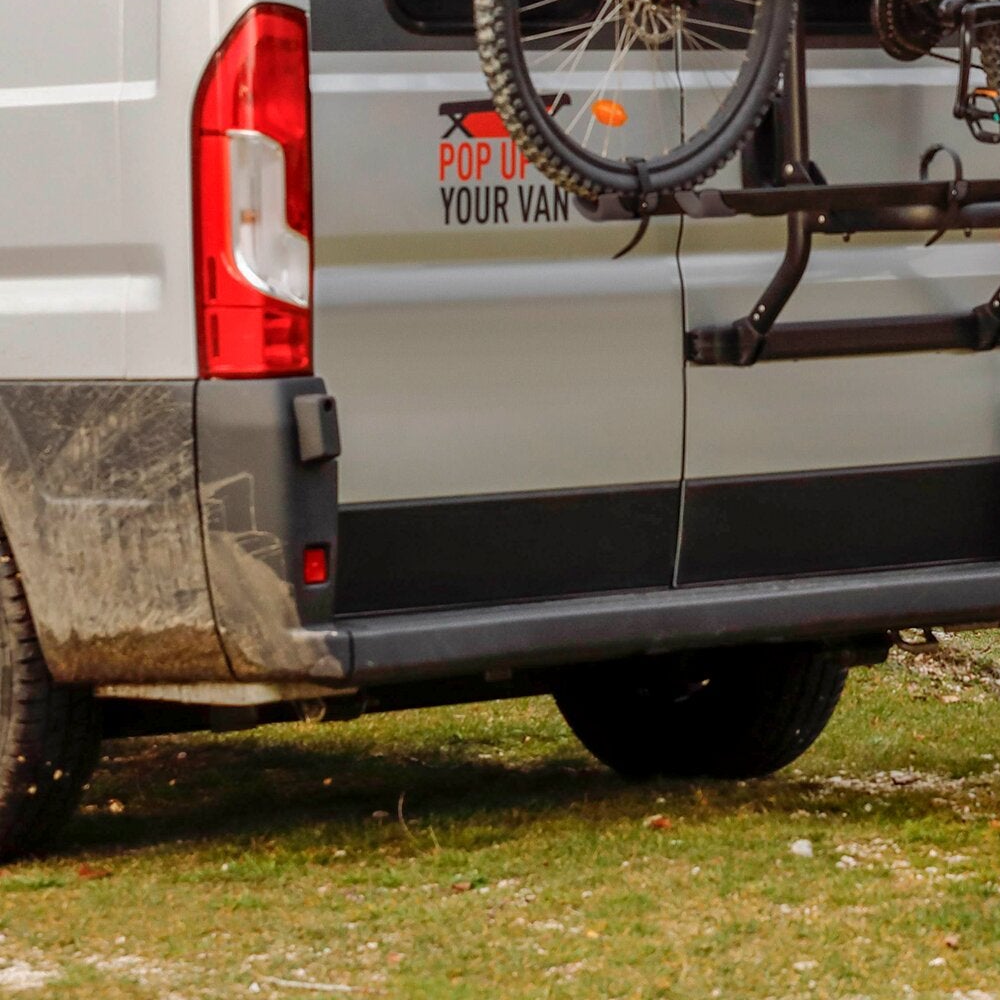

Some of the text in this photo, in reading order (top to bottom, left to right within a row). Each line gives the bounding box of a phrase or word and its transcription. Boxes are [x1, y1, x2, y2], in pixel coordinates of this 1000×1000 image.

[439, 142, 492, 181] POP
[440, 185, 569, 224] YOUR VAN
